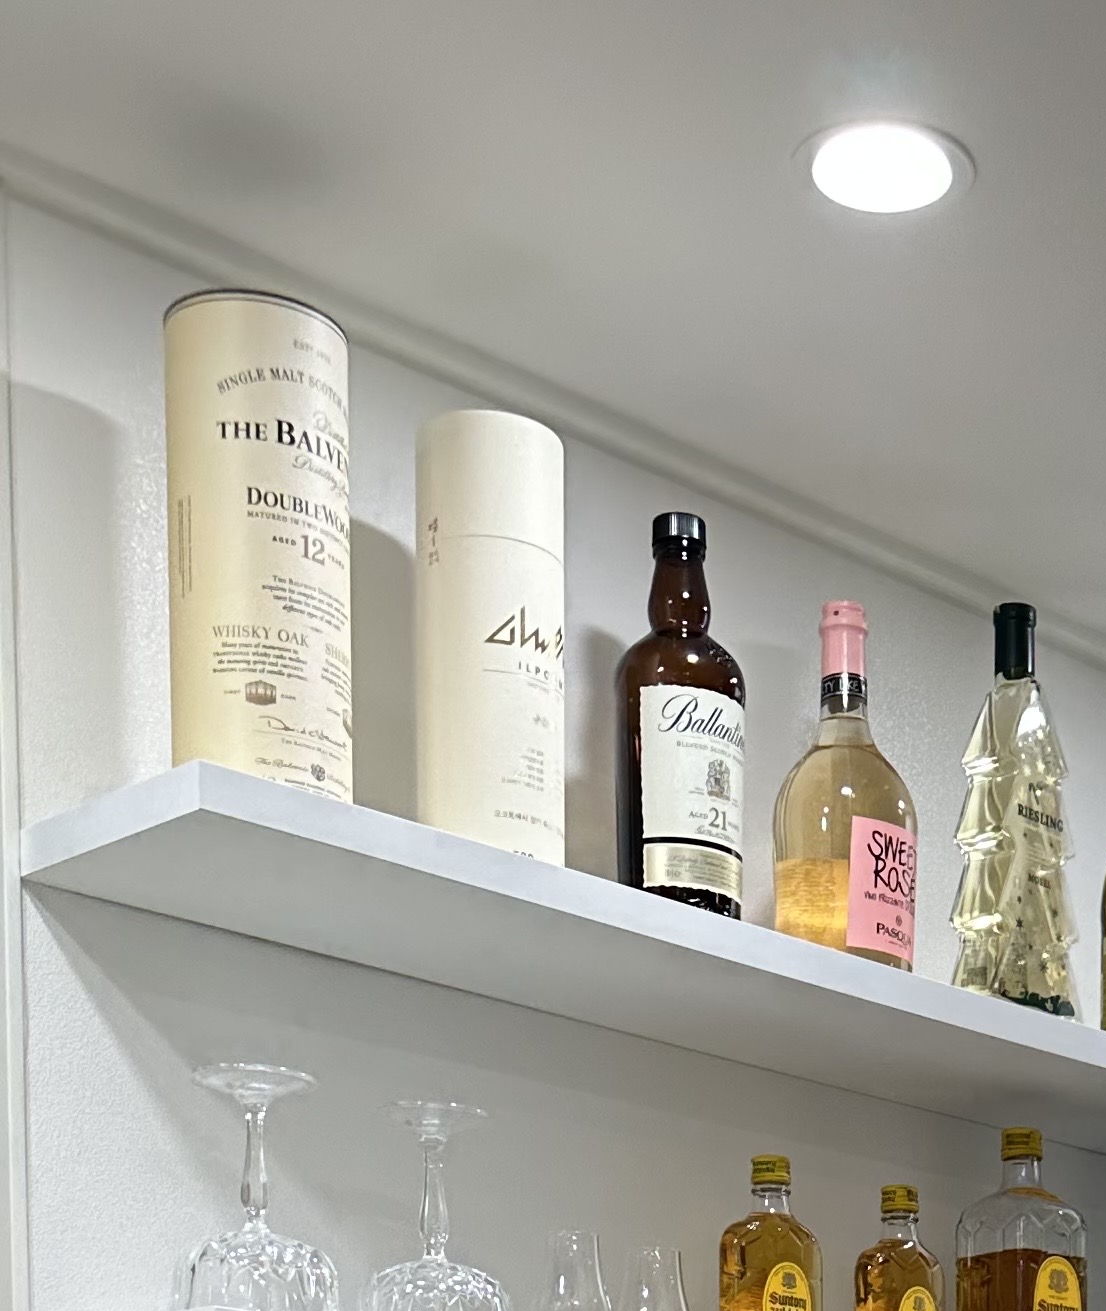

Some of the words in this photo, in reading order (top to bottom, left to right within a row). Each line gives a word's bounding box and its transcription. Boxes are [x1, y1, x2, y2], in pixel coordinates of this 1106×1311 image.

[216, 367, 266, 394] SINGLE
[270, 367, 305, 384] MALT
[216, 420, 268, 441] THE
[272, 535, 297, 547] AGED
[301, 534, 325, 566] 12
[212, 624, 271, 640] WHISKY
[277, 629, 310, 648] OAK
[658, 694, 745, 750] Ballantin
[708, 807, 727, 831] 21
[1018, 803, 1064, 832] RIESLING
[769, 1291, 807, 1310] Suntory
